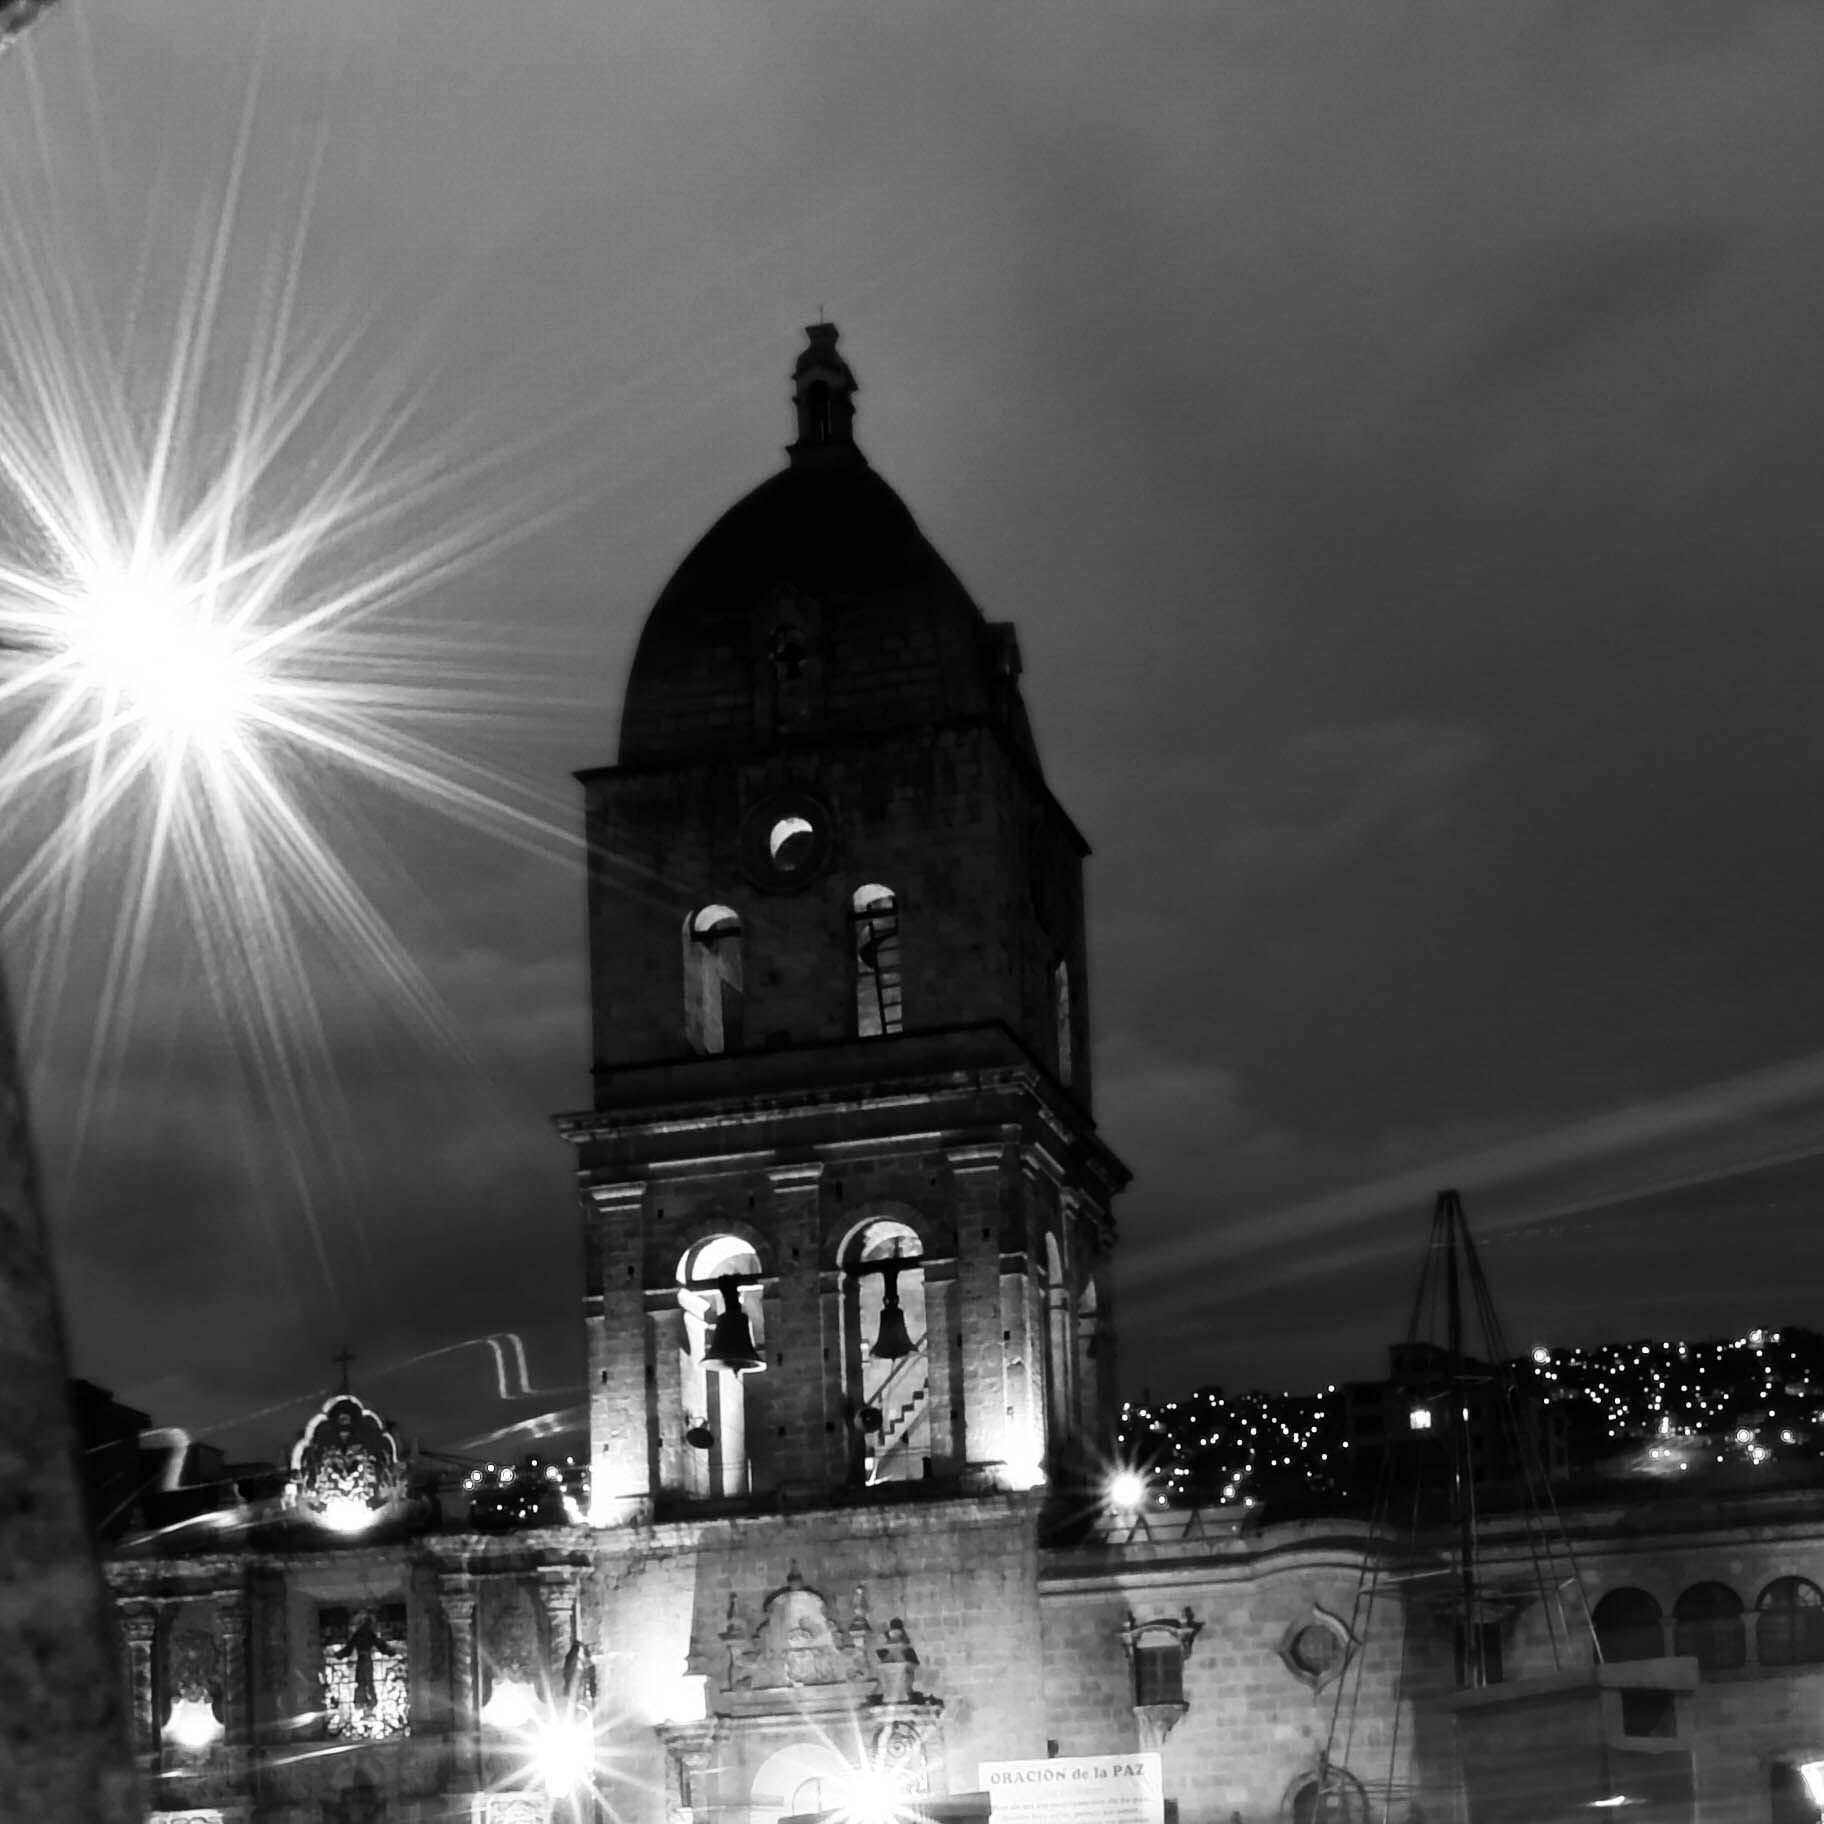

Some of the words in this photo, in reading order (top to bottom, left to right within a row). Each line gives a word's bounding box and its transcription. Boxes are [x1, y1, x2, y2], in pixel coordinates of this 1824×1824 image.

[990, 1767, 1066, 1785] ORACIÓN
[1071, 1768, 1090, 1781] de
[1093, 1766, 1108, 1779] la
[1112, 1763, 1146, 1778] PAZ
